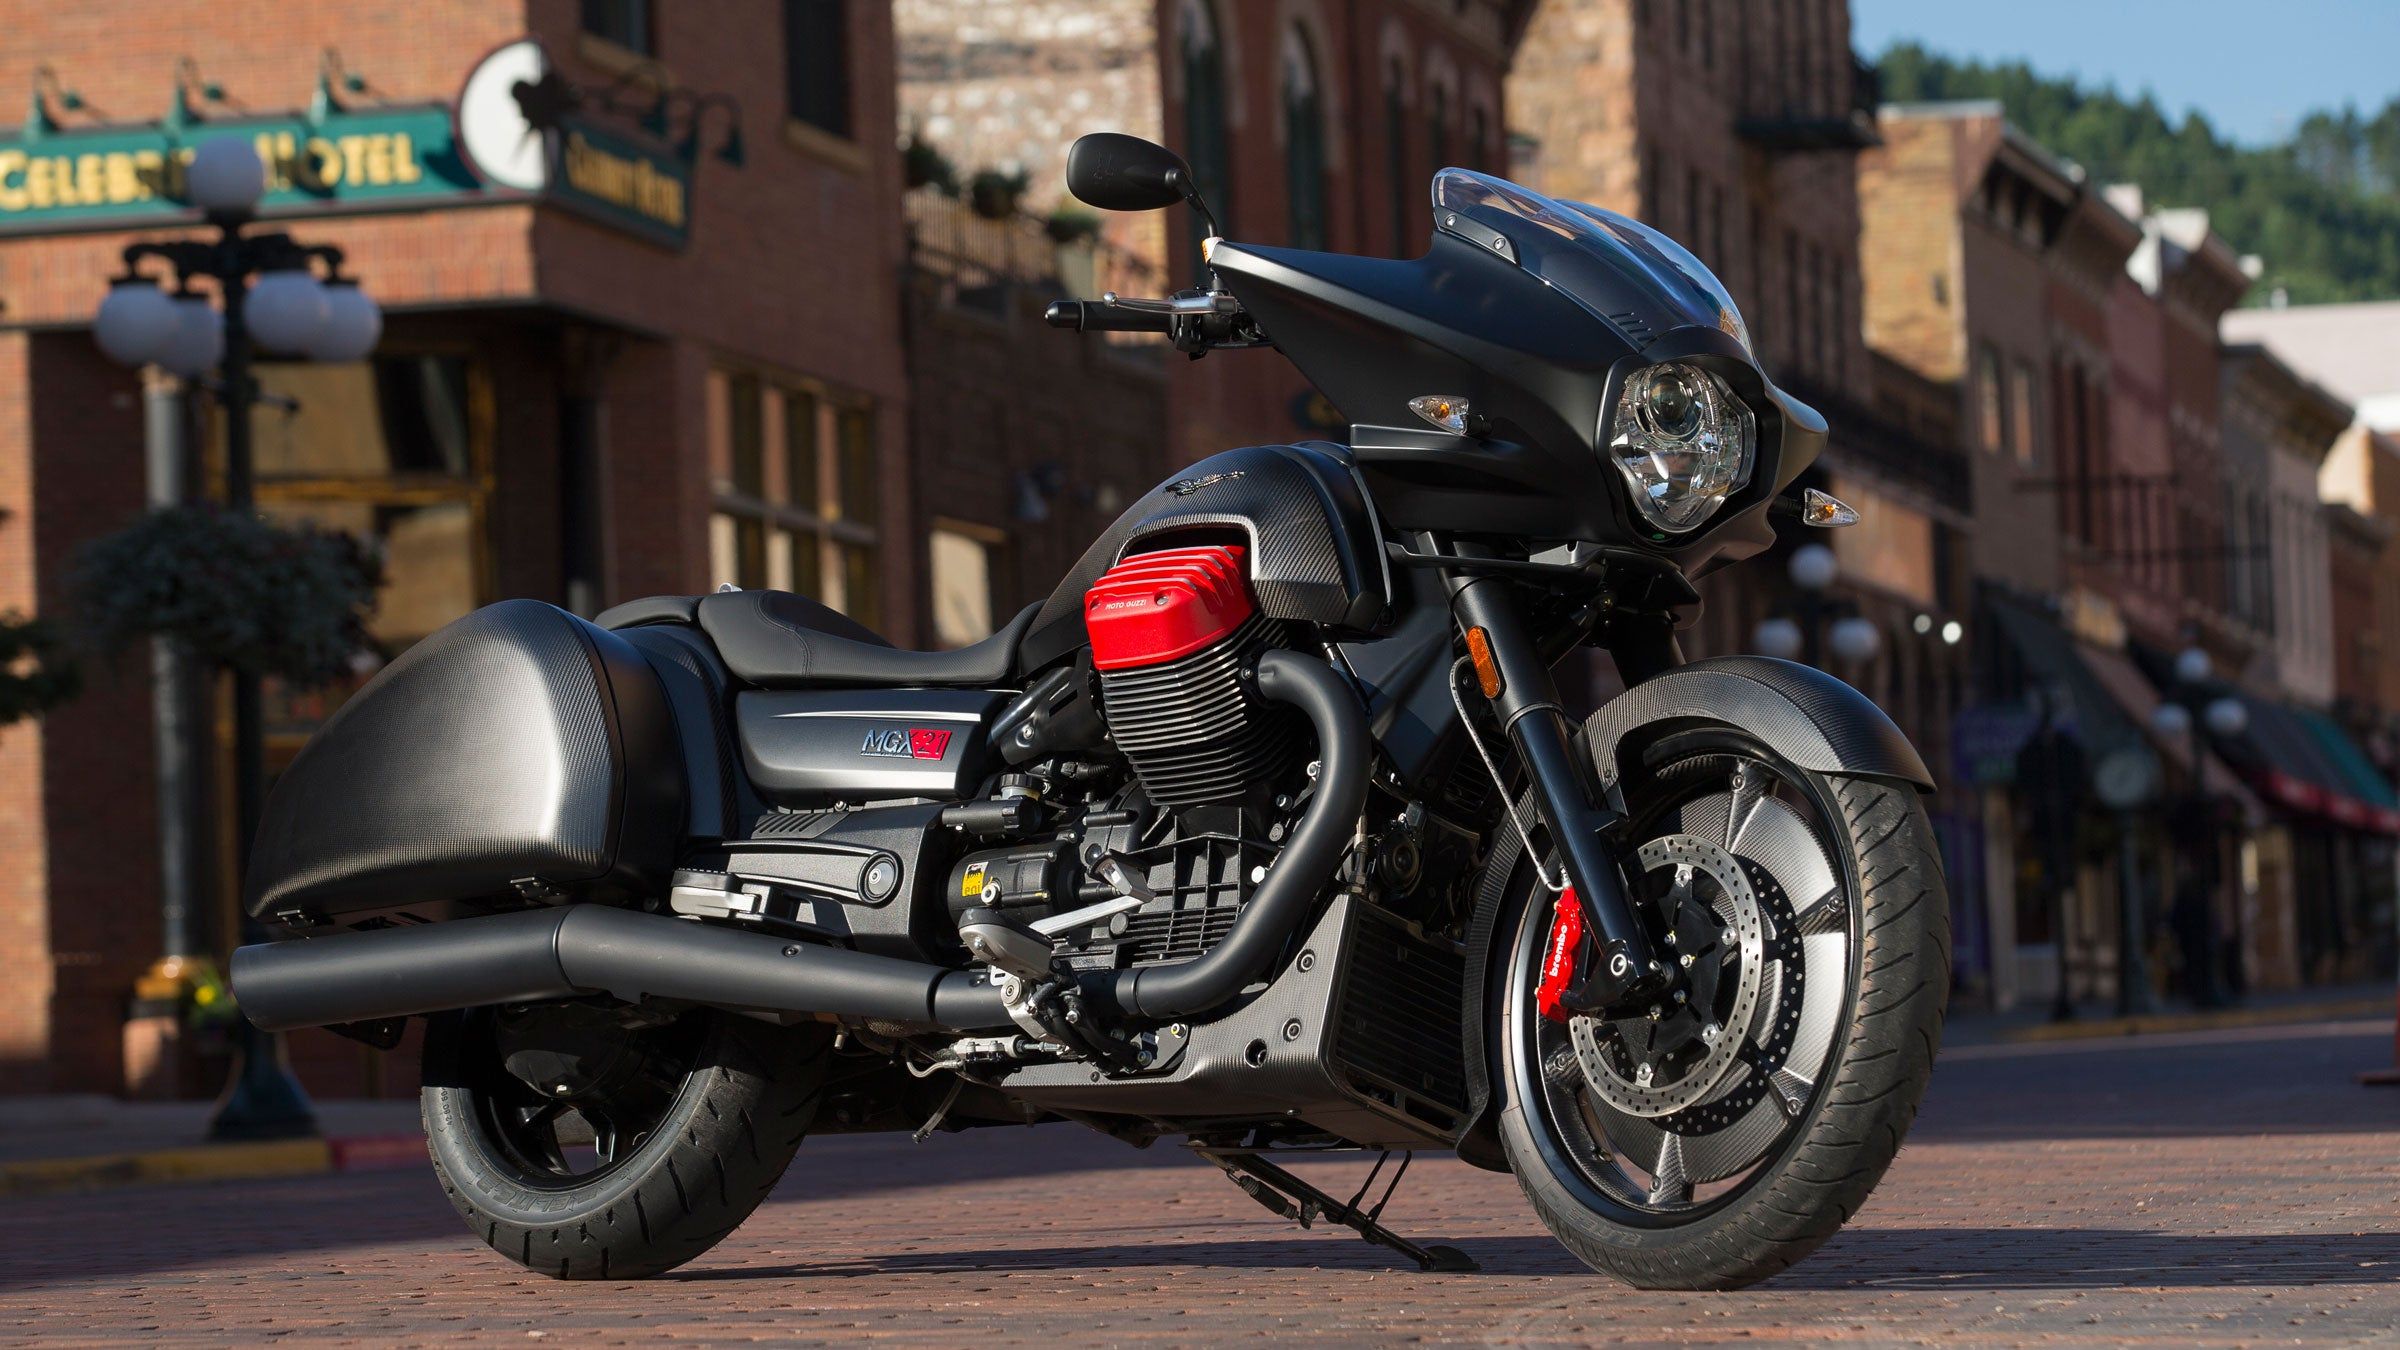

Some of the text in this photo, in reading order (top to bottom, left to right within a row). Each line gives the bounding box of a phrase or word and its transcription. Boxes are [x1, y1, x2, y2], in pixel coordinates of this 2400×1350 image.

[255, 132, 421, 192] HOTEL
[1105, 599, 1147, 610] MOTO GUZZI
[964, 880, 981, 895] eni
[1549, 924, 1568, 977] brembo
